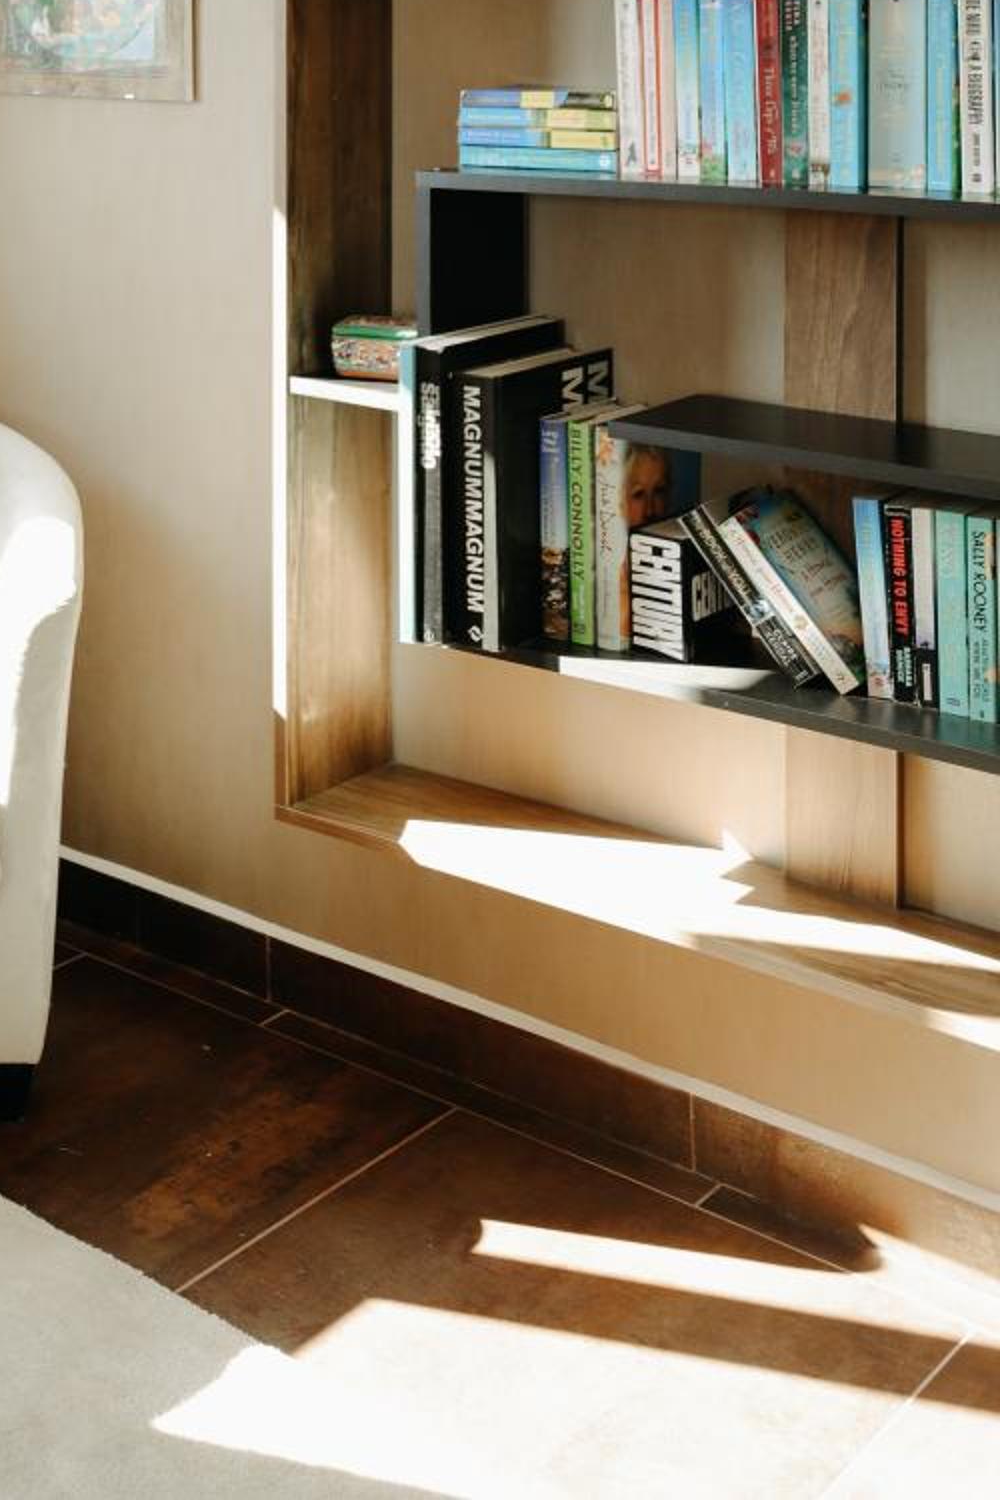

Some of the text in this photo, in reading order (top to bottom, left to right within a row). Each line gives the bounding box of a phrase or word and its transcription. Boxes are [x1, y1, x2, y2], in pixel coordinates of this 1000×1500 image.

[463, 385, 484, 614] MAGNUMMAGNUM
[570, 428, 584, 476] BILLY
[571, 481, 584, 580] CONNOLLY
[889, 518, 909, 637] NOTHING TO ENVY
[971, 531, 987, 633] SALLY ROONEY
[629, 534, 685, 661] CENTURY
